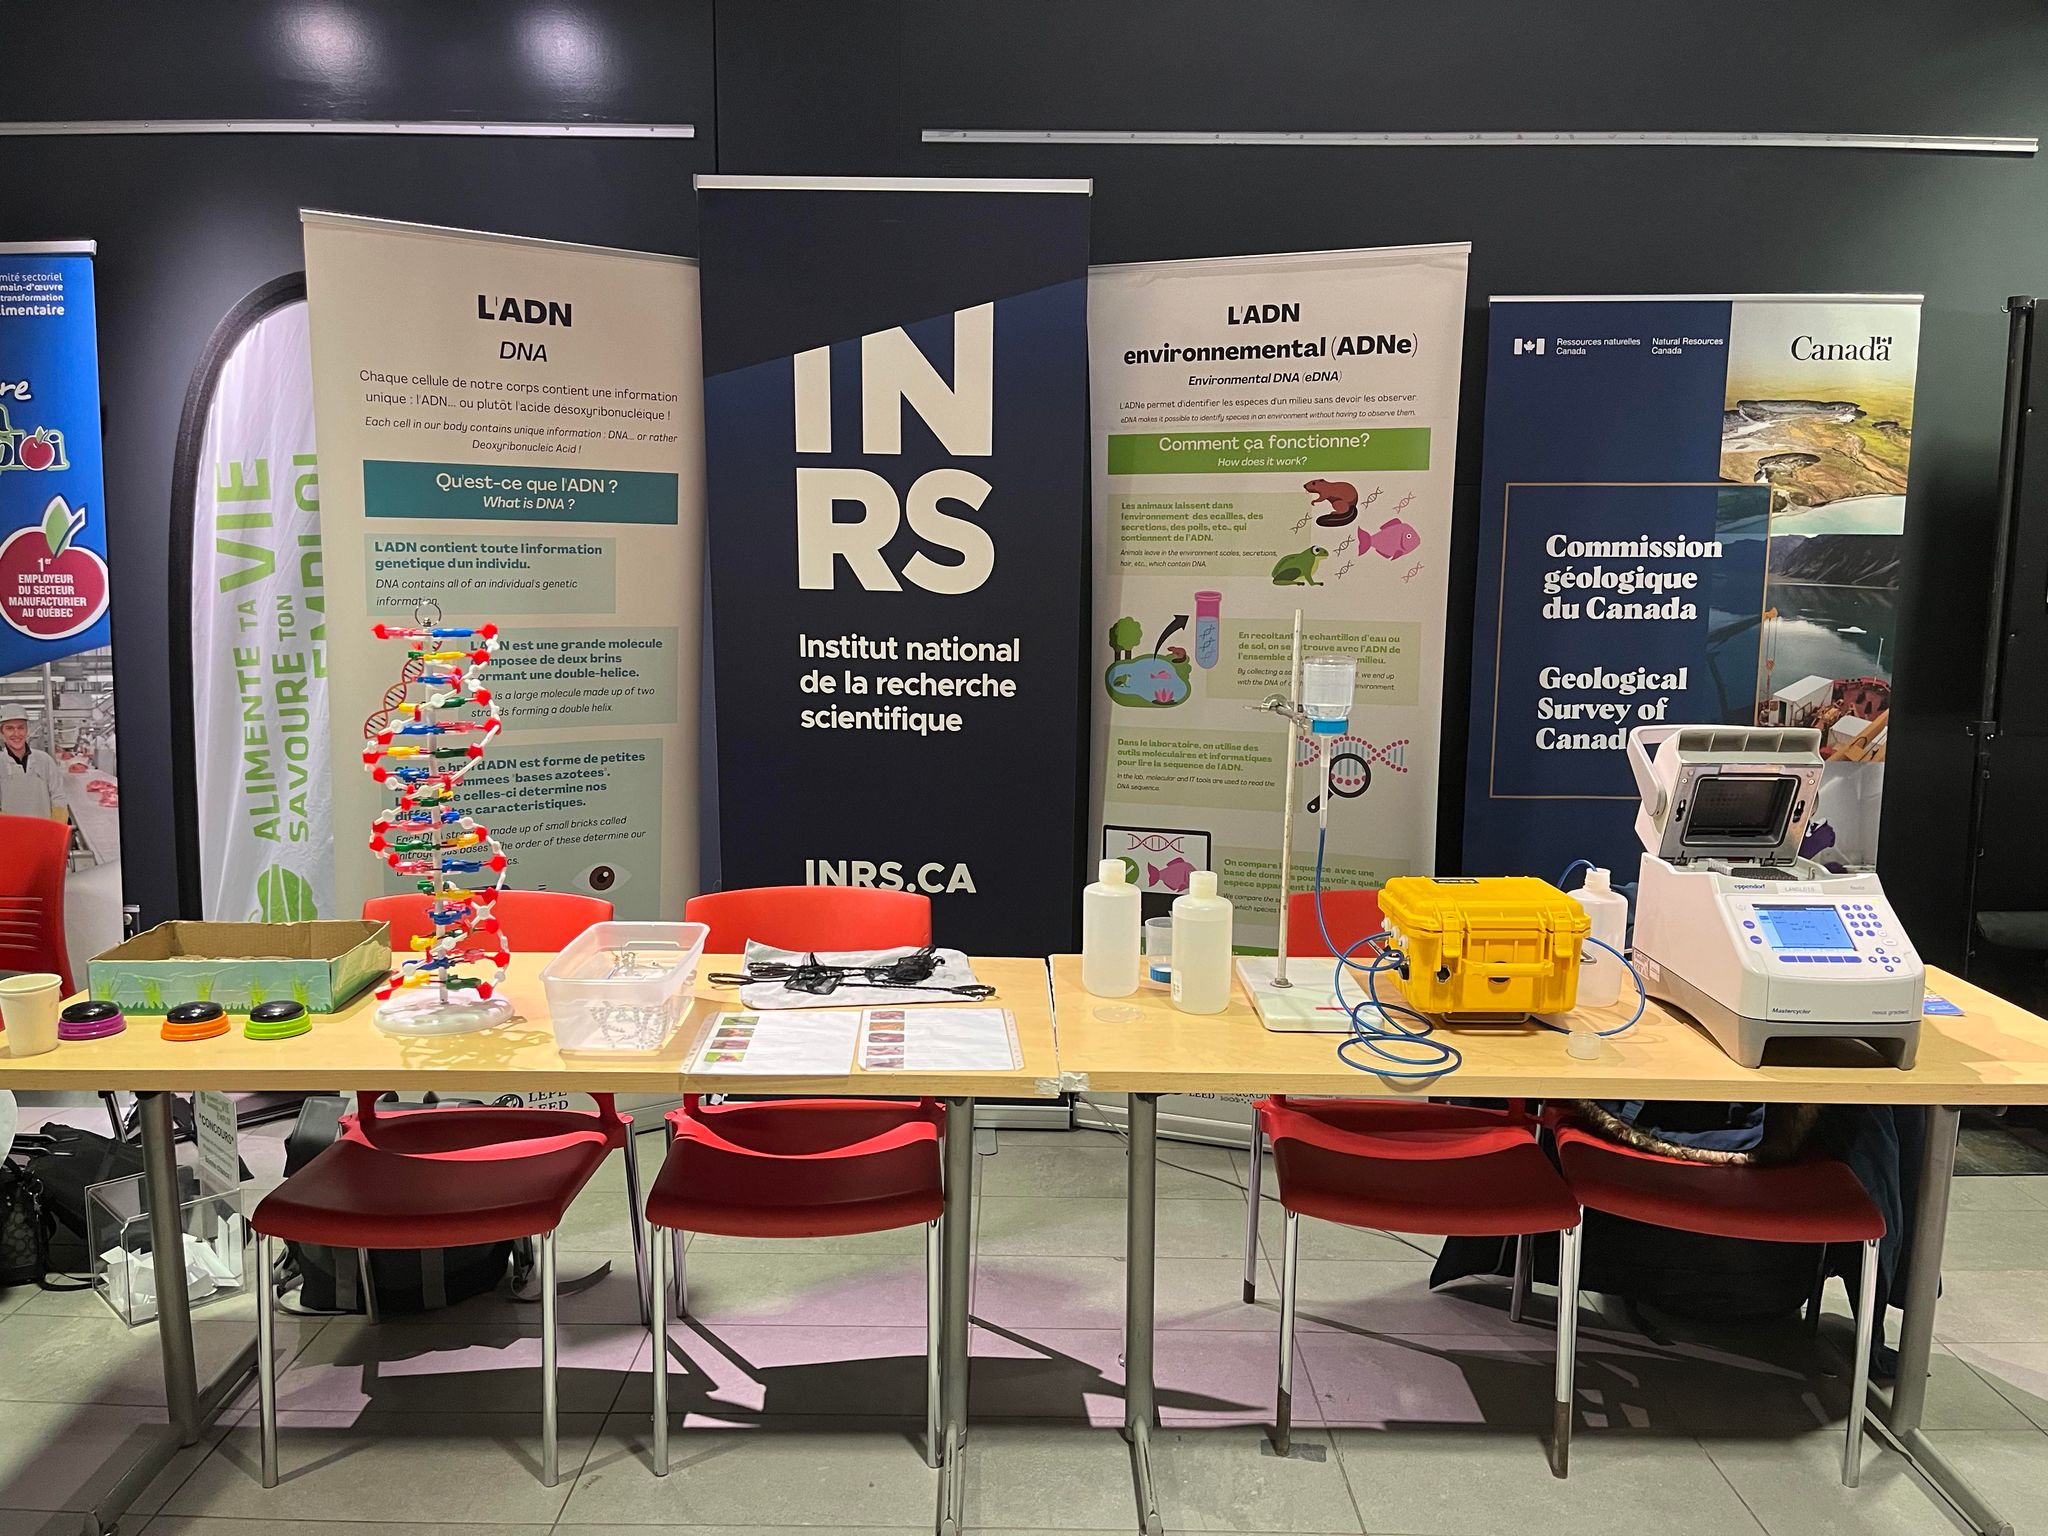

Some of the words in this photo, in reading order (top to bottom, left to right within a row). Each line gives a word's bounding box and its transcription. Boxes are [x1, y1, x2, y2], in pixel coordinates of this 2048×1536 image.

[22, 273, 63, 281] sectoriel
[478, 295, 572, 326] L'ADN
[1228, 303, 1300, 324] L'ADN
[500, 341, 547, 361] DNA
[1124, 338, 1326, 363] environnemental
[1331, 334, 1418, 357] (ADNe)
[1556, 337, 1602, 346] Ressources
[1604, 337, 1641, 345] naturelles
[1556, 346, 1586, 354] Canada
[1651, 346, 1682, 354] Canada
[1652, 337, 1680, 348] Natural
[1682, 337, 1724, 345] Resources
[1791, 335, 1893, 361] Canada
[360, 369, 408, 385] Chaque
[412, 374, 449, 386] cellule
[452, 376, 467, 388] de
[470, 380, 503, 390] notre
[506, 383, 540, 394] corps
[542, 385, 590, 396] contient
[592, 389, 612, 397] une
[614, 388, 678, 401] information
[793, 302, 994, 456] IN
[1188, 373, 1272, 385] Environmental
[1273, 372, 1300, 382] DNA
[1302, 371, 1342, 381] (eDNA)
[366, 392, 406, 405] unique
[459, 399, 474, 408] ou
[477, 398, 512, 410] plutôt
[1146, 401, 1176, 410] permet
[1222, 398, 1234, 406] les
[1288, 396, 1312, 404] milieu
[1335, 394, 1362, 403] devoir
[1364, 394, 1376, 402] les
[365, 416, 391, 426] Each
[393, 418, 411, 427] cell
[413, 418, 422, 428] in
[424, 421, 442, 429] our
[443, 420, 468, 433] body
[470, 424, 512, 433] contains
[514, 425, 544, 436] unique
[546, 426, 602, 438] information
[649, 433, 678, 442] rather
[472, 439, 554, 452] Deoxyribonucleic
[555, 443, 577, 453] Acid
[1159, 437, 1240, 450] Comment
[1244, 438, 1264, 452] ça
[1268, 433, 1370, 448] fonctionne?
[1218, 457, 1240, 466] How
[1241, 457, 1265, 466] does
[1266, 456, 1274, 465] it
[1276, 456, 1308, 465] work?
[436, 473, 522, 490] Qu'est-ce
[526, 480, 557, 493] que
[562, 477, 604, 492] l'ADN
[483, 495, 521, 508] What
[523, 496, 533, 508] is
[536, 497, 564, 509] DNA
[216, 458, 275, 594] VIE
[796, 467, 995, 594] RS
[420, 541, 478, 552] contient
[480, 543, 518, 553] toute
[1545, 534, 1723, 559] Commission
[476, 557, 530, 568] individu.
[18, 574, 74, 584] EMPLOYEUR
[376, 578, 399, 588] DNA
[401, 579, 445, 588] contains
[447, 578, 459, 588] all
[460, 578, 473, 588] of
[474, 580, 486, 588] an
[488, 578, 540, 588] individual's
[542, 579, 578, 590] genetic
[1543, 566, 1698, 594] géologique
[18, 586, 31, 595] DU
[33, 586, 75, 595] SECTEUR
[9, 597, 87, 606] MANUFACTURIER
[1542, 596, 1580, 619] du
[1586, 596, 1698, 619] Canada
[22, 608, 34, 618] AU
[37, 606, 73, 618] QUÉBEC
[239, 599, 258, 632] TA
[277, 594, 295, 642] TON
[470, 641, 509, 651] L'AN
[512, 640, 534, 650] est
[561, 638, 606, 651] grande
[800, 634, 898, 659] Institut
[907, 637, 1020, 661] national
[540, 654, 555, 664] de
[557, 653, 588, 663] deux
[590, 652, 622, 662] brins
[800, 669, 836, 693] de
[845, 670, 868, 694] la
[876, 673, 1016, 696] recherche
[1539, 667, 1688, 694] Geological
[494, 690, 502, 700] is
[513, 688, 538, 701] large
[540, 688, 581, 698] molecule
[583, 687, 609, 697] made
[611, 688, 623, 698] up
[624, 686, 636, 696] of
[637, 687, 655, 695] two
[471, 705, 509, 717] strads
[512, 706, 549, 718] forming
[551, 706, 557, 714] a
[559, 703, 590, 713] double
[801, 705, 962, 734] scientifique
[1538, 697, 1632, 725] Survey
[1635, 697, 1668, 720] of
[233, 646, 282, 844] ALIMENTE
[272, 651, 312, 844] SAVOURE
[1535, 730, 1629, 751] Canad
[489, 824, 517, 835] made
[519, 825, 531, 834] up
[532, 822, 544, 831] of
[545, 820, 570, 830] small
[570, 818, 598, 828] bricks
[600, 816, 627, 826] called
[805, 860, 977, 894] INRS.CA
